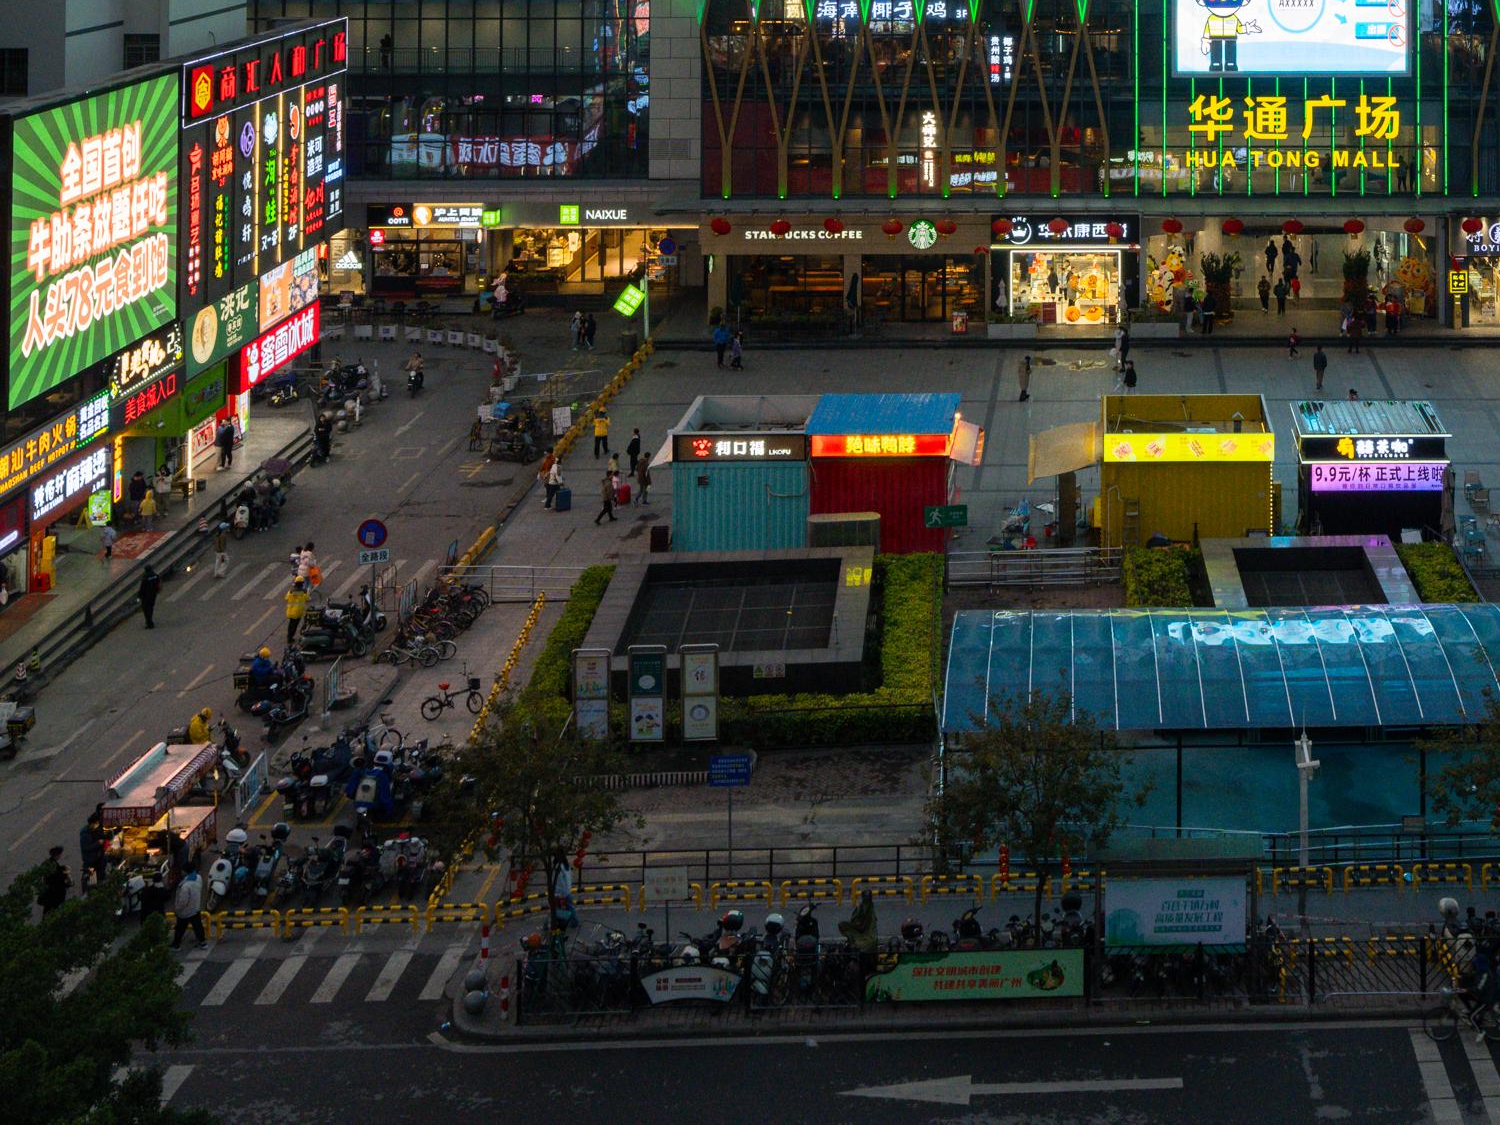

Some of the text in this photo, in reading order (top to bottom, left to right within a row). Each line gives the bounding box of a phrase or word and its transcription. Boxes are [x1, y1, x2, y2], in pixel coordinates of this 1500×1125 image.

[818, 1, 946, 19] 海南椰子鸡
[220, 32, 345, 101] 商汇人和广场
[1188, 95, 1400, 141] 华通广场
[59, 120, 142, 206] 全国首创
[1186, 151, 1400, 167] HUA TONG MALL
[586, 210, 627, 221] NAIXUE
[745, 230, 816, 240] STARUCKS
[260, 308, 314, 376] 蜜雪冰城
[125, 373, 176, 424] 美食城入口
[715, 440, 765, 455] 利口福
[1315, 466, 1443, 483] 9.9元/杯 正式上线啦
